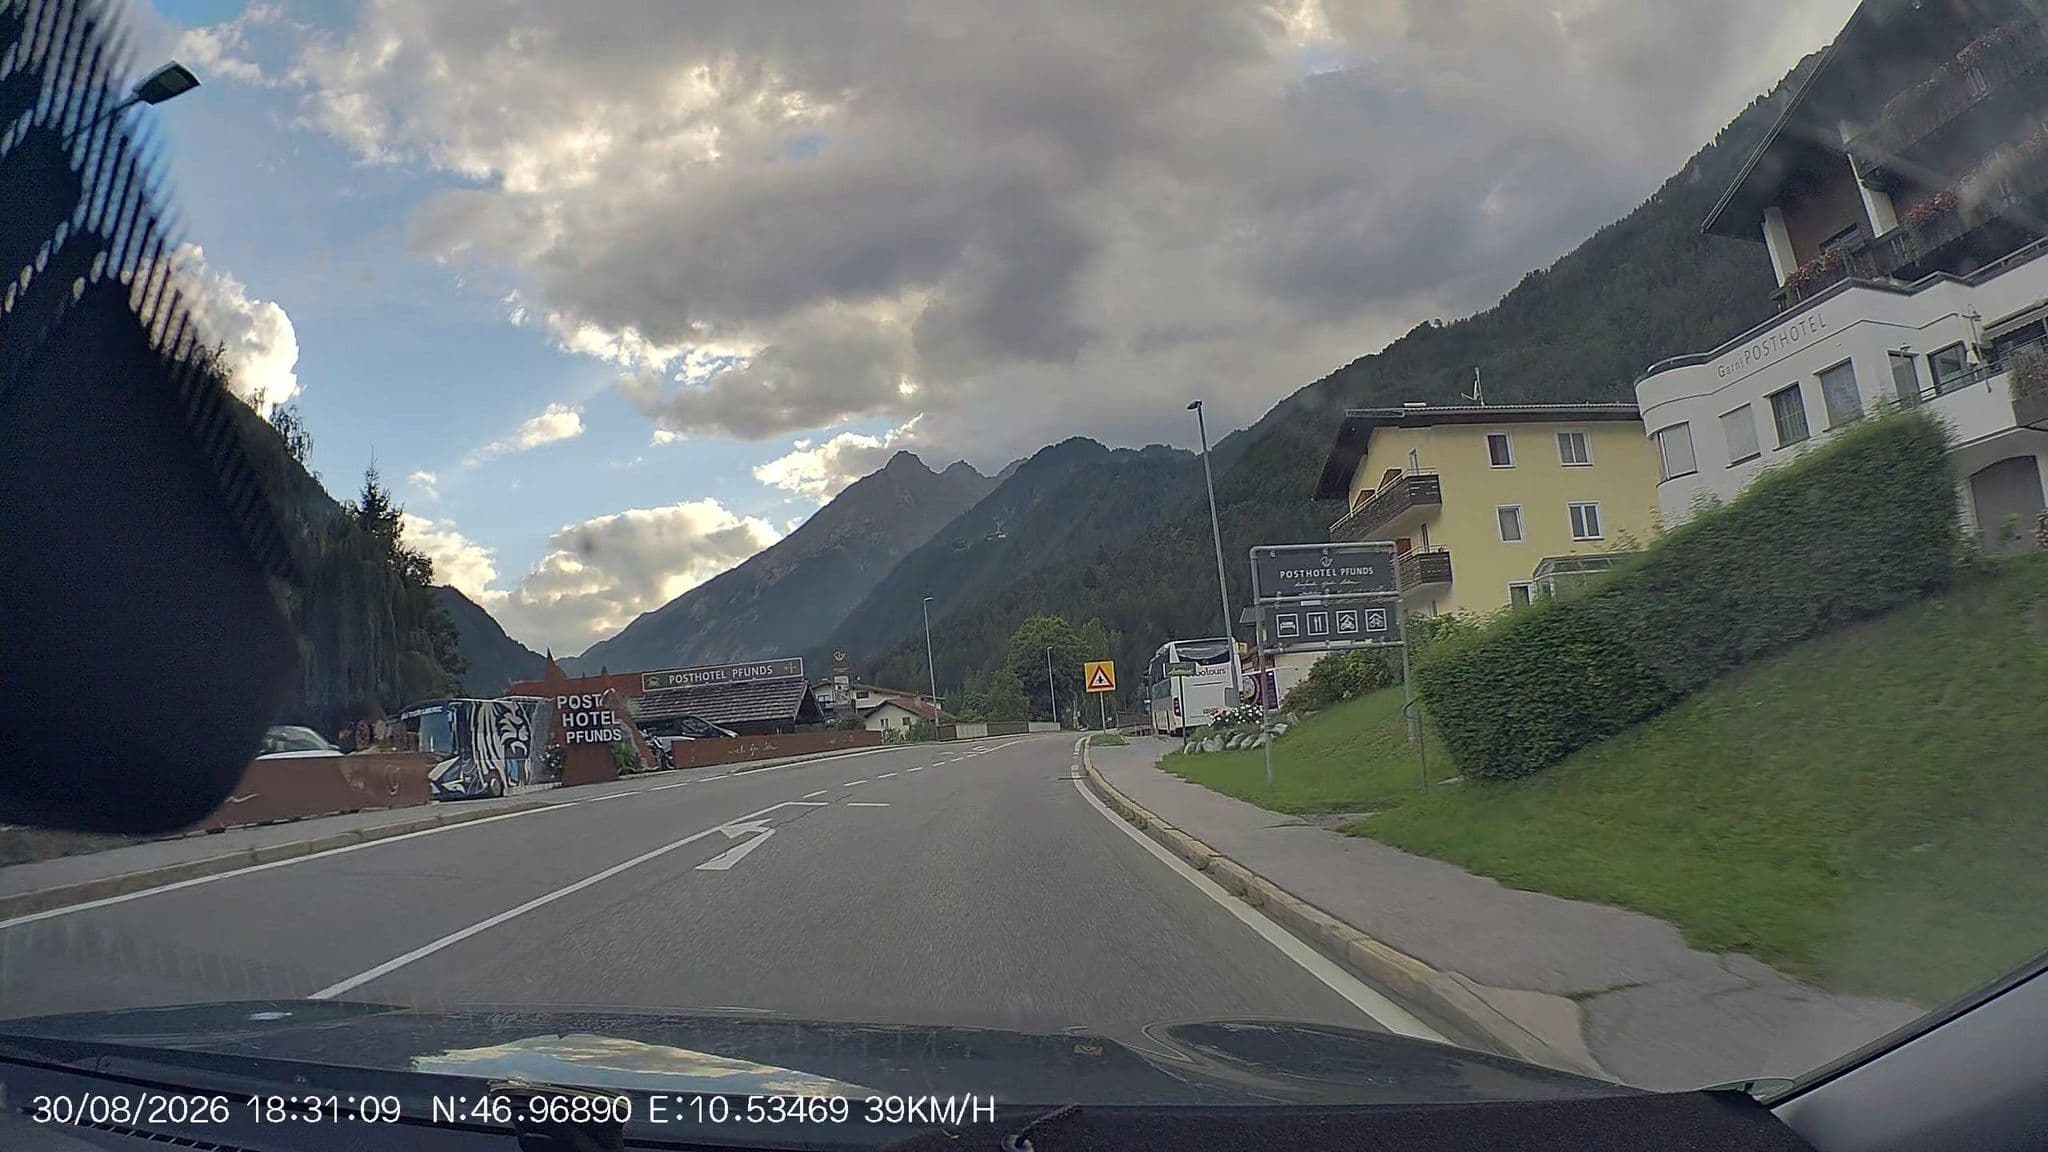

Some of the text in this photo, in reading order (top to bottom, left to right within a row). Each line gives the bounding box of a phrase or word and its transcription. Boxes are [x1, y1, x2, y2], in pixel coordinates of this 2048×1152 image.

[1744, 312, 1826, 365] POSTHOTEL
[1280, 567, 1374, 579] POSTHOTEL PFUNDS
[669, 665, 773, 684] POSTHOTEL PFUNDS
[557, 694, 602, 710] POST
[562, 711, 620, 727] HOTEL
[566, 729, 622, 744] PFUNDS
